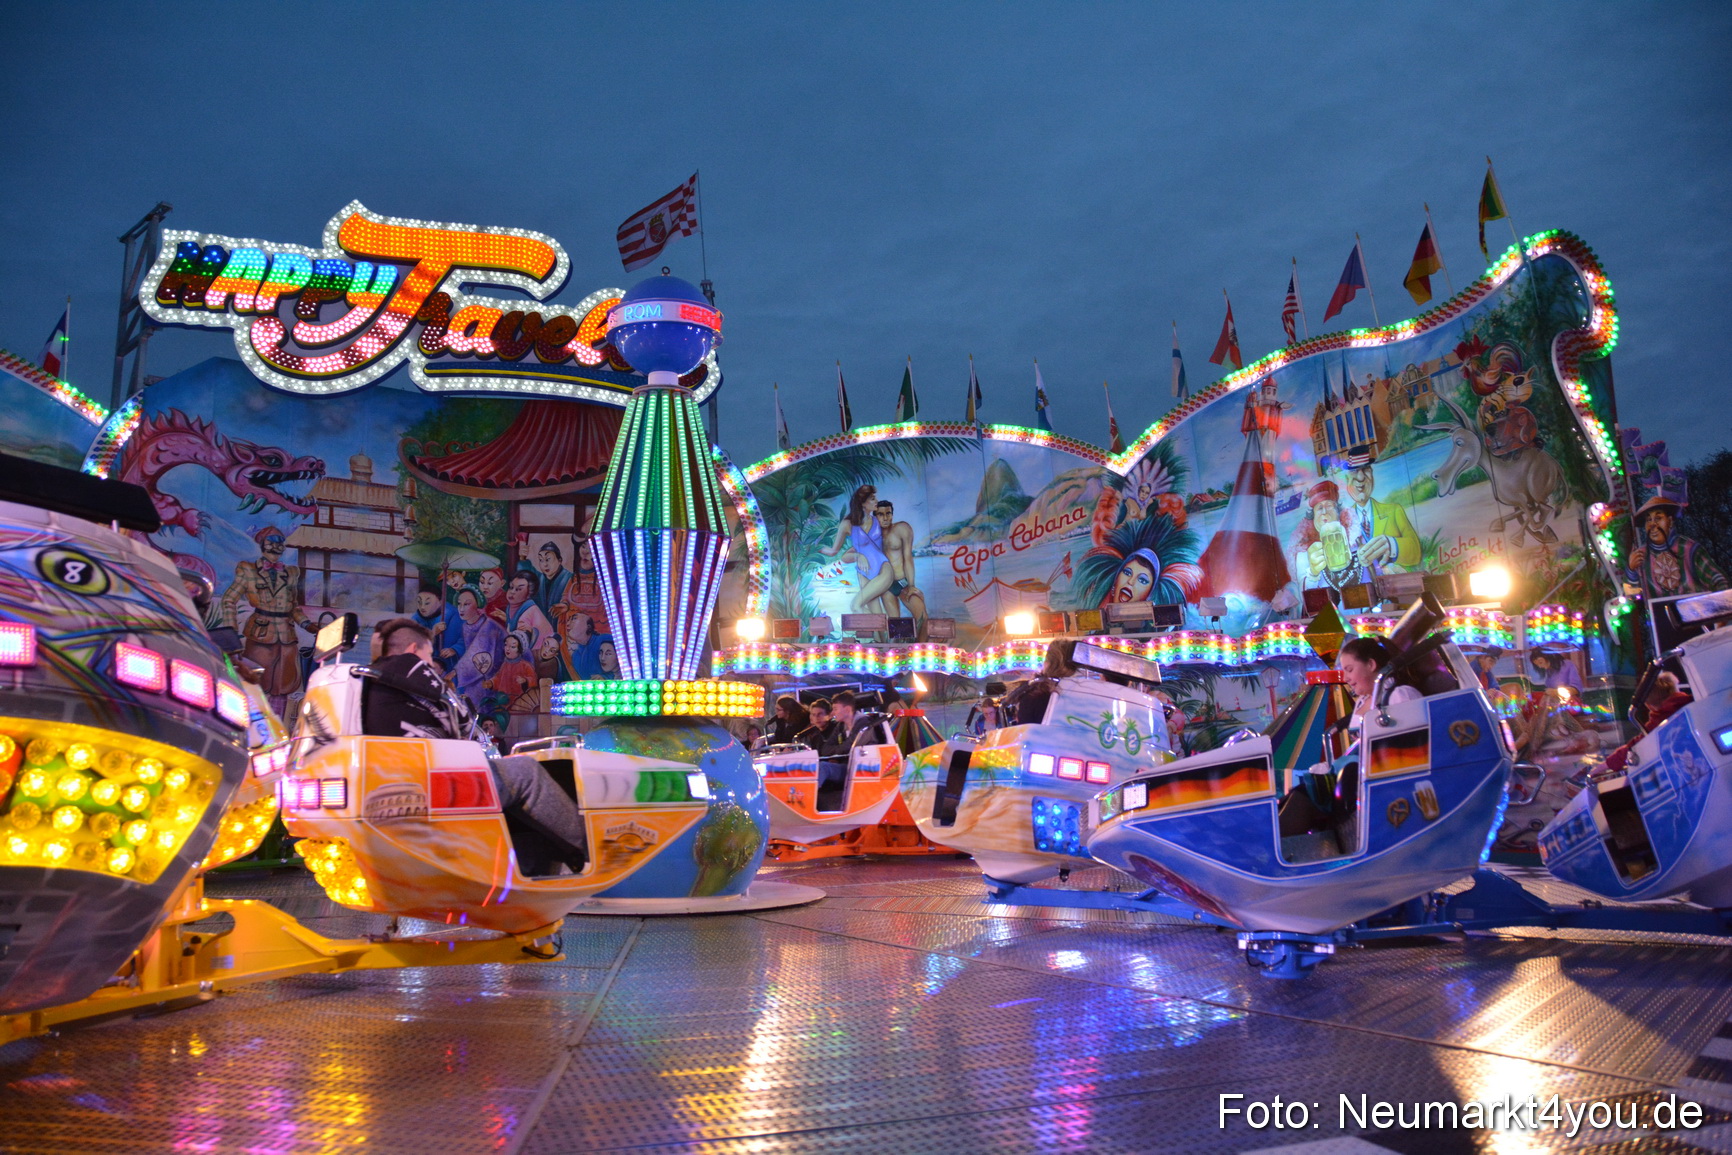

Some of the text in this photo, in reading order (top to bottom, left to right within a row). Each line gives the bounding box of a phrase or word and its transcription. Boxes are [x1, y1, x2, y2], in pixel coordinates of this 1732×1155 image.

[624, 304, 662, 322] ROM
[949, 507, 1087, 575] Copa Cabana
[64, 561, 87, 584] 8
